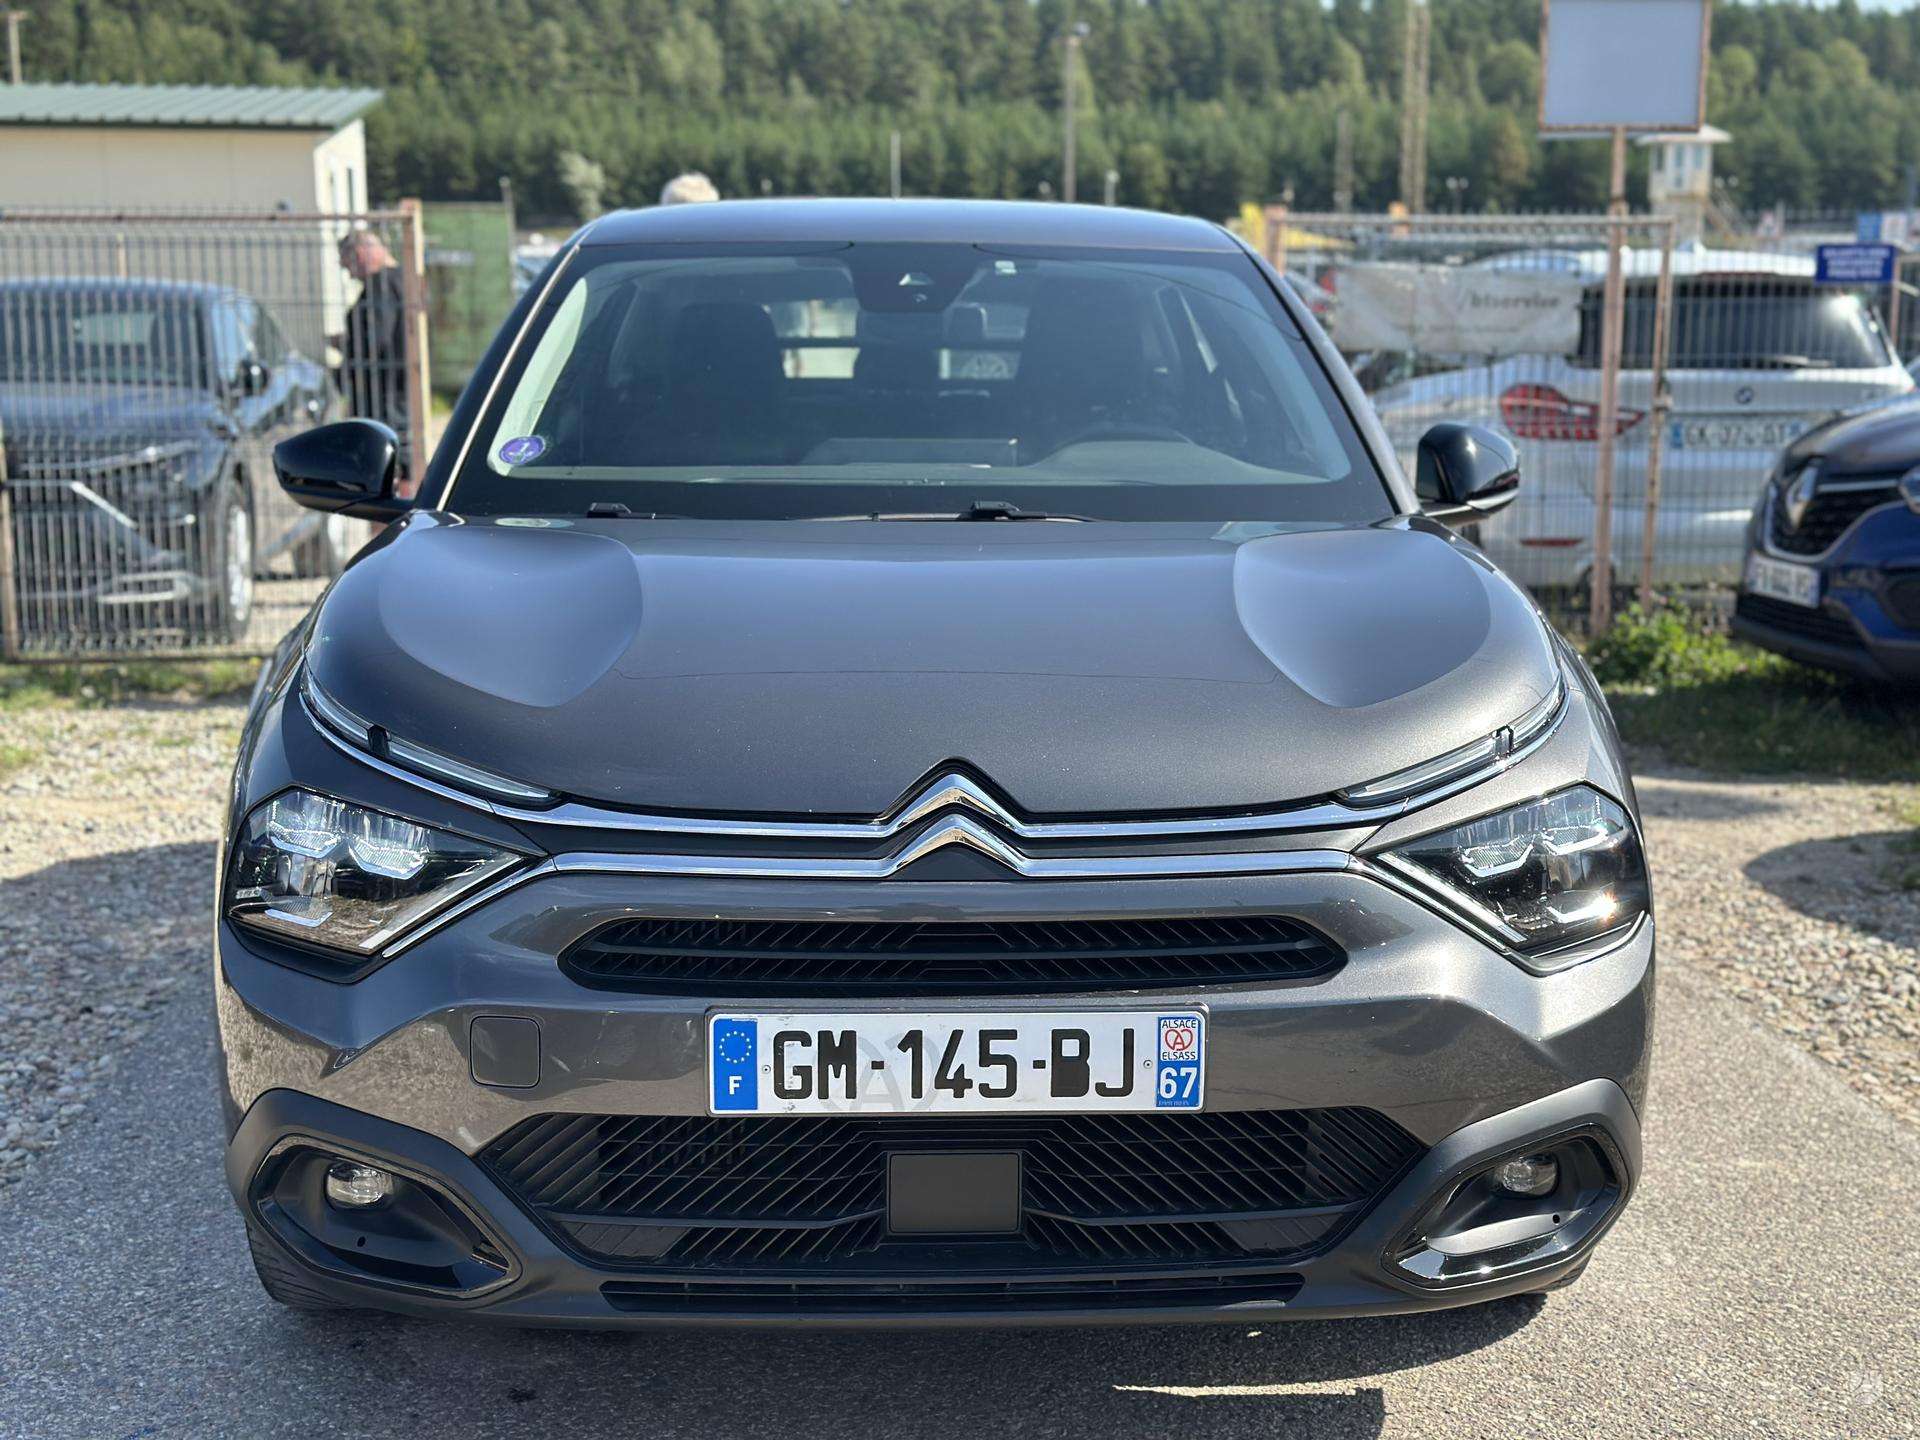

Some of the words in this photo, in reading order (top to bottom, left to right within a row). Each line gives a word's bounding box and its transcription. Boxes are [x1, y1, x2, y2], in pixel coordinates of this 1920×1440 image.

[1162, 1019, 1196, 1029] ALSACE
[773, 1028, 1135, 1100] GM-145-BJ
[1162, 1051, 1196, 1060] ELSASS
[729, 1075, 742, 1095] F
[1160, 1067, 1198, 1099] 67
